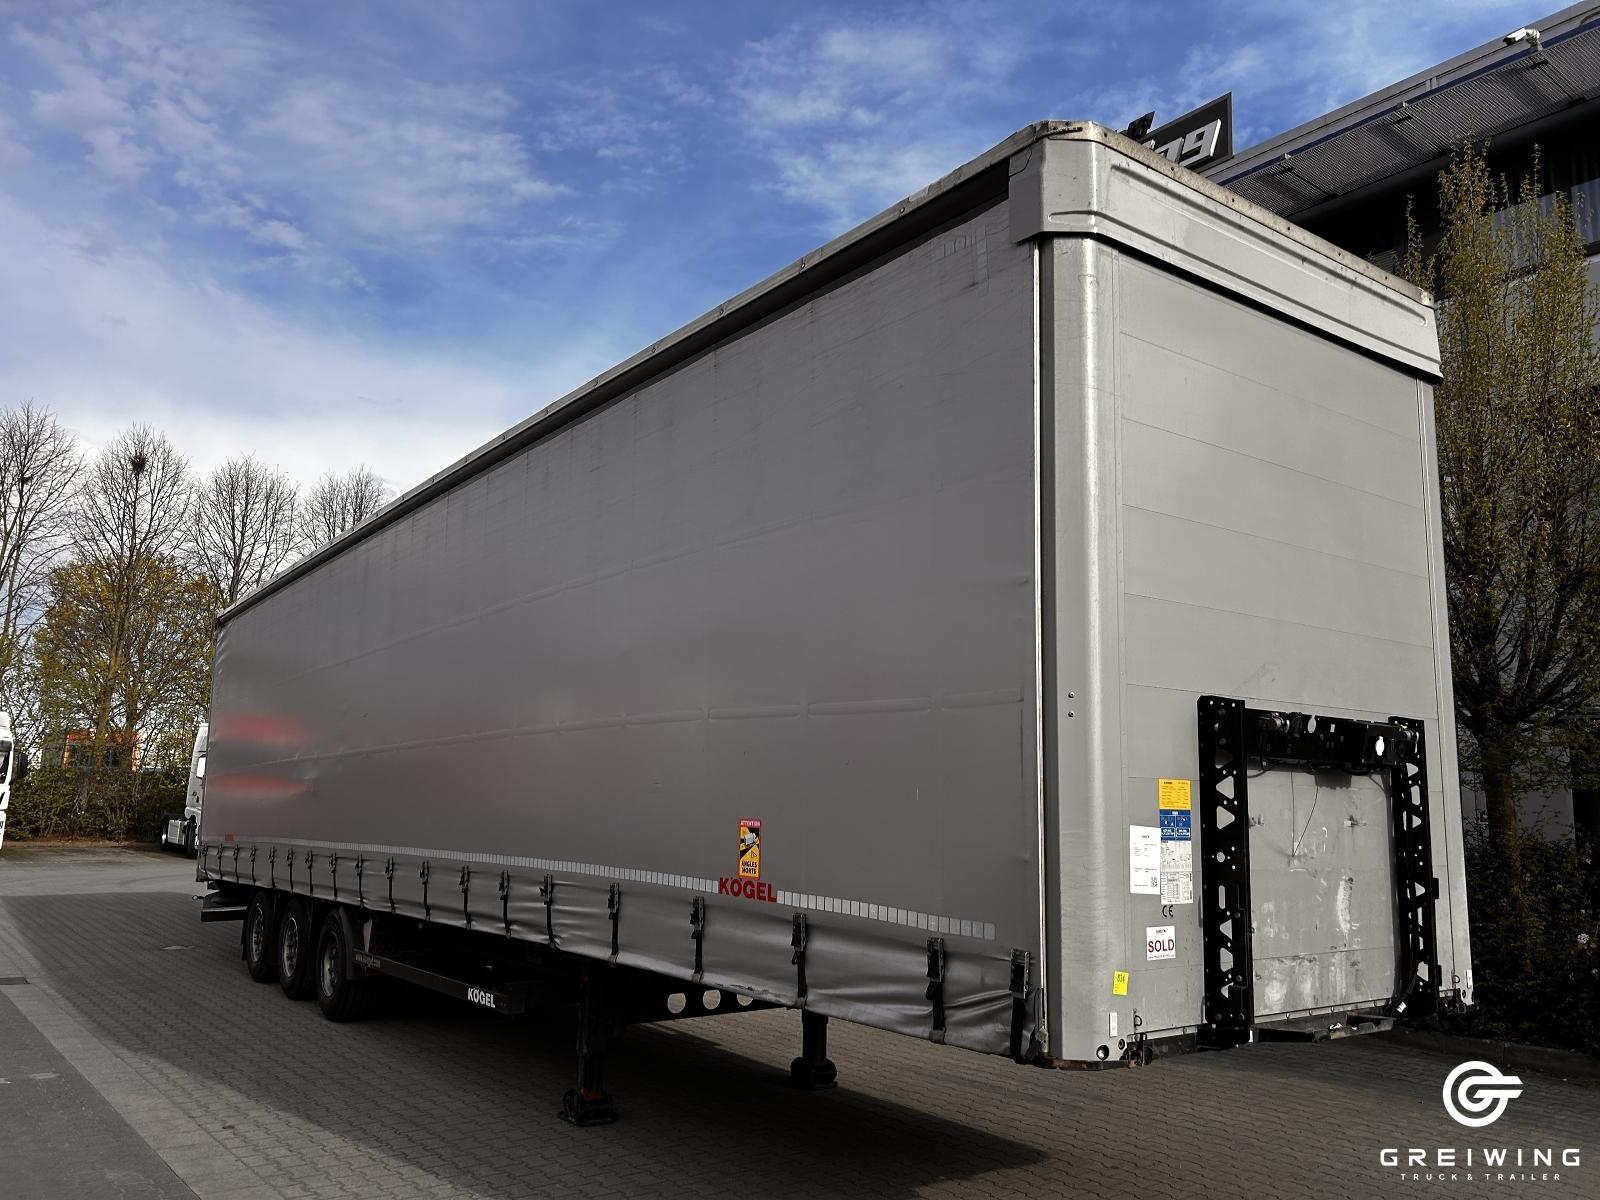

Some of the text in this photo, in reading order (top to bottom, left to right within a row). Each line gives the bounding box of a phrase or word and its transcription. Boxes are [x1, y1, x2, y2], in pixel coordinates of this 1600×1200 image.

[741, 860, 758, 868] ANGLES
[741, 867, 757, 875] MORTS
[719, 877, 777, 903] KÖGEL
[1148, 939, 1175, 953] SOLD
[467, 987, 496, 1009] KÖGEL
